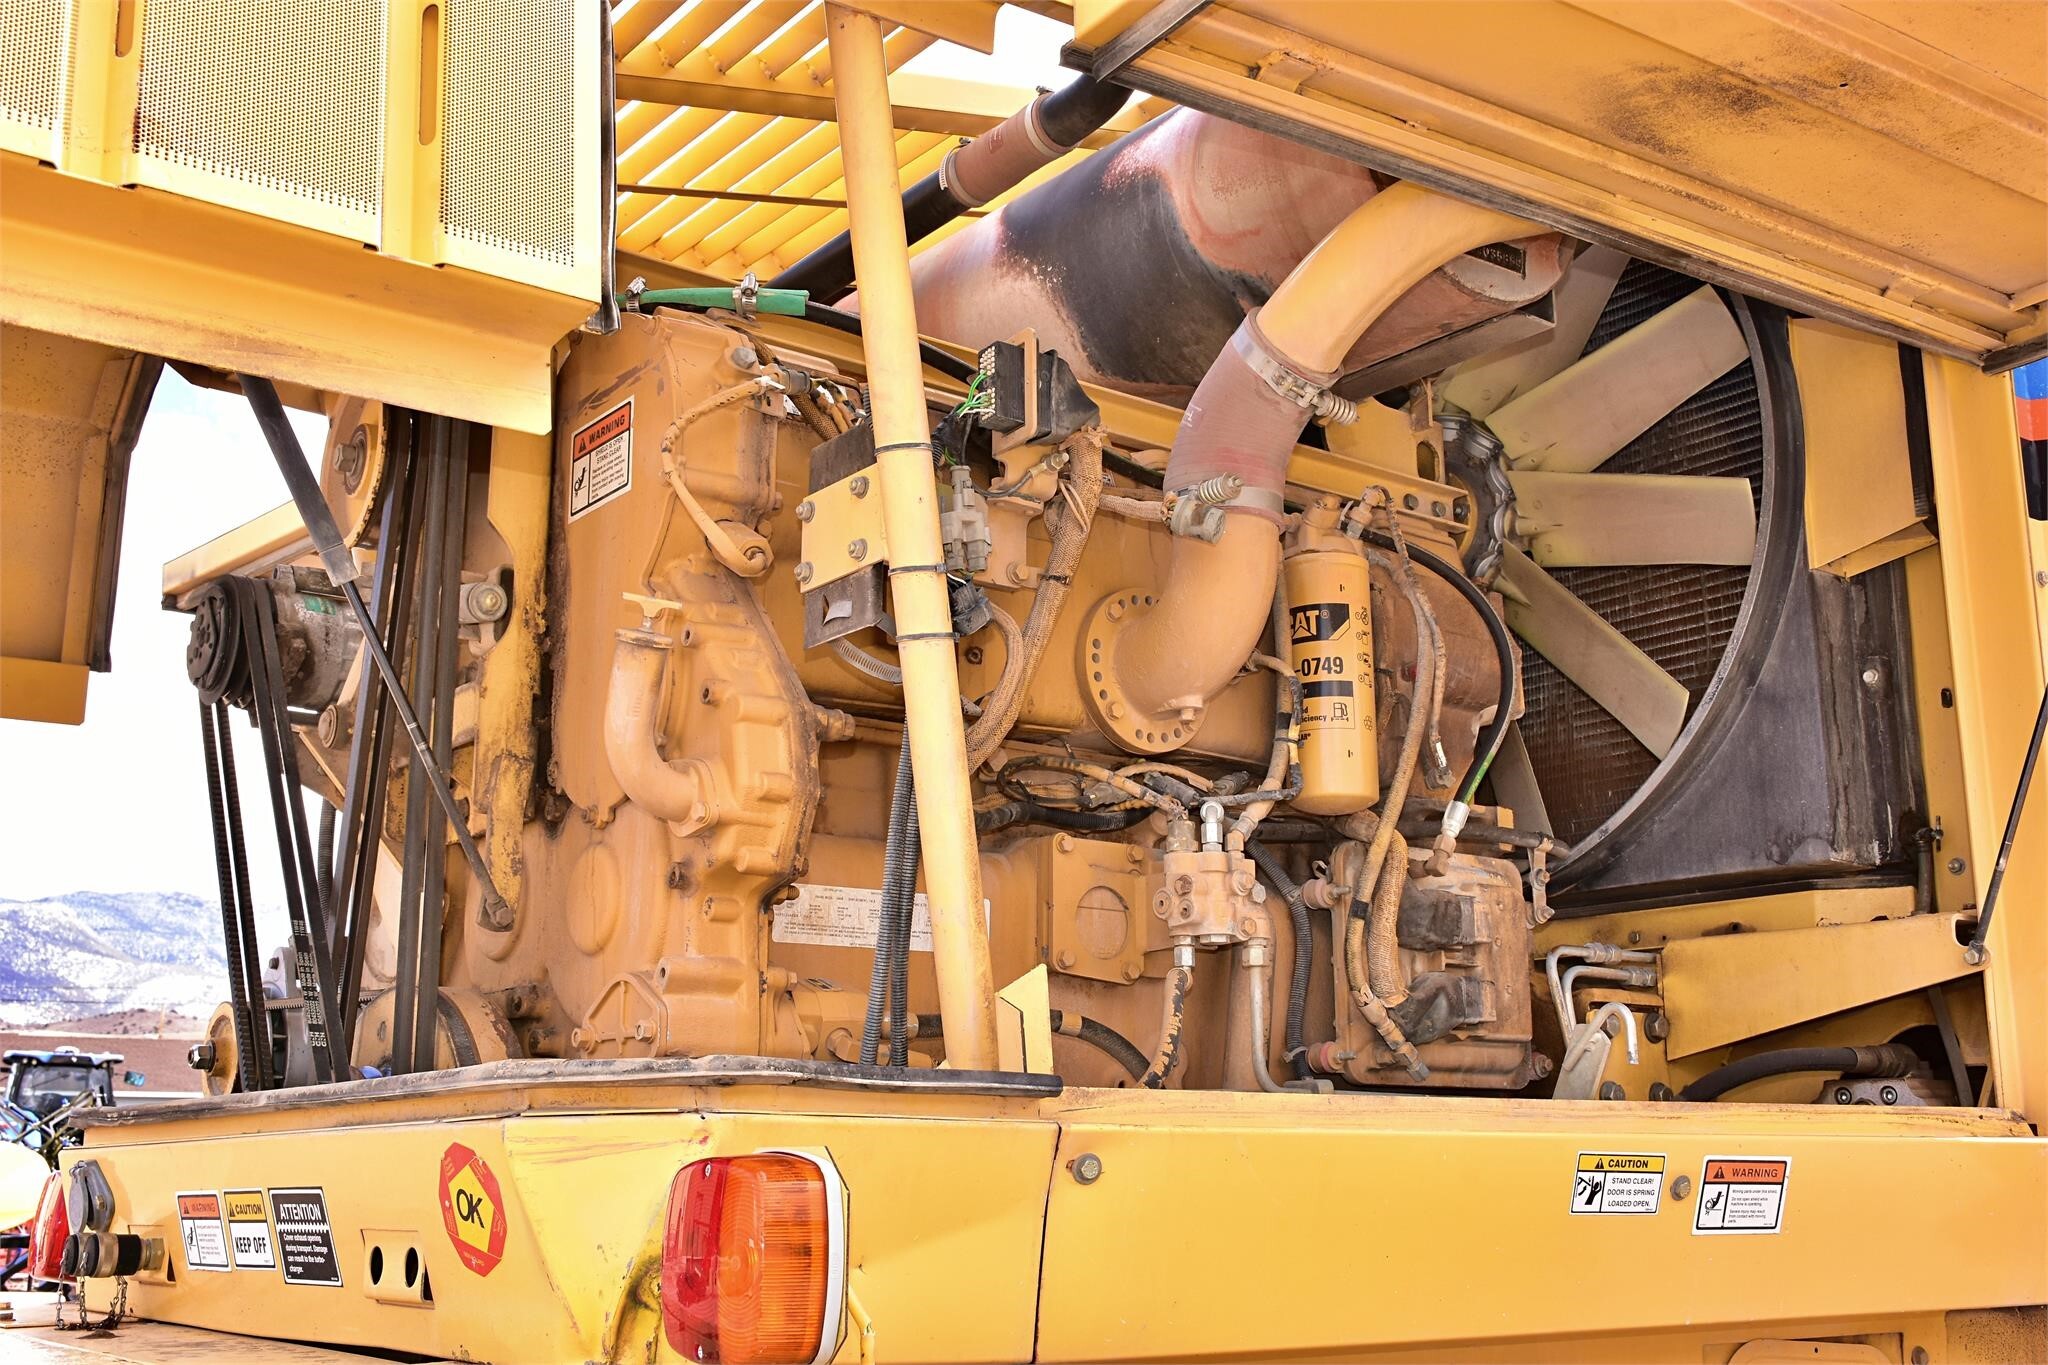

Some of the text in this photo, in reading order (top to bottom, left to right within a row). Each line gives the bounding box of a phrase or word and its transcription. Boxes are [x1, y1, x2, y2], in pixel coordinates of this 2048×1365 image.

[588, 414, 625, 444] WARNING
[1295, 656, 1344, 676] -0749
[1301, 714, 1327, 724] iciency
[1608, 1159, 1649, 1168] CAUTION
[1732, 1168, 1778, 1178] WARNING
[235, 1204, 263, 1215] CAUTION
[280, 1204, 322, 1220] ATTENTION
[456, 1188, 485, 1229] OK
[235, 1236, 266, 1253] KEEP OFF
